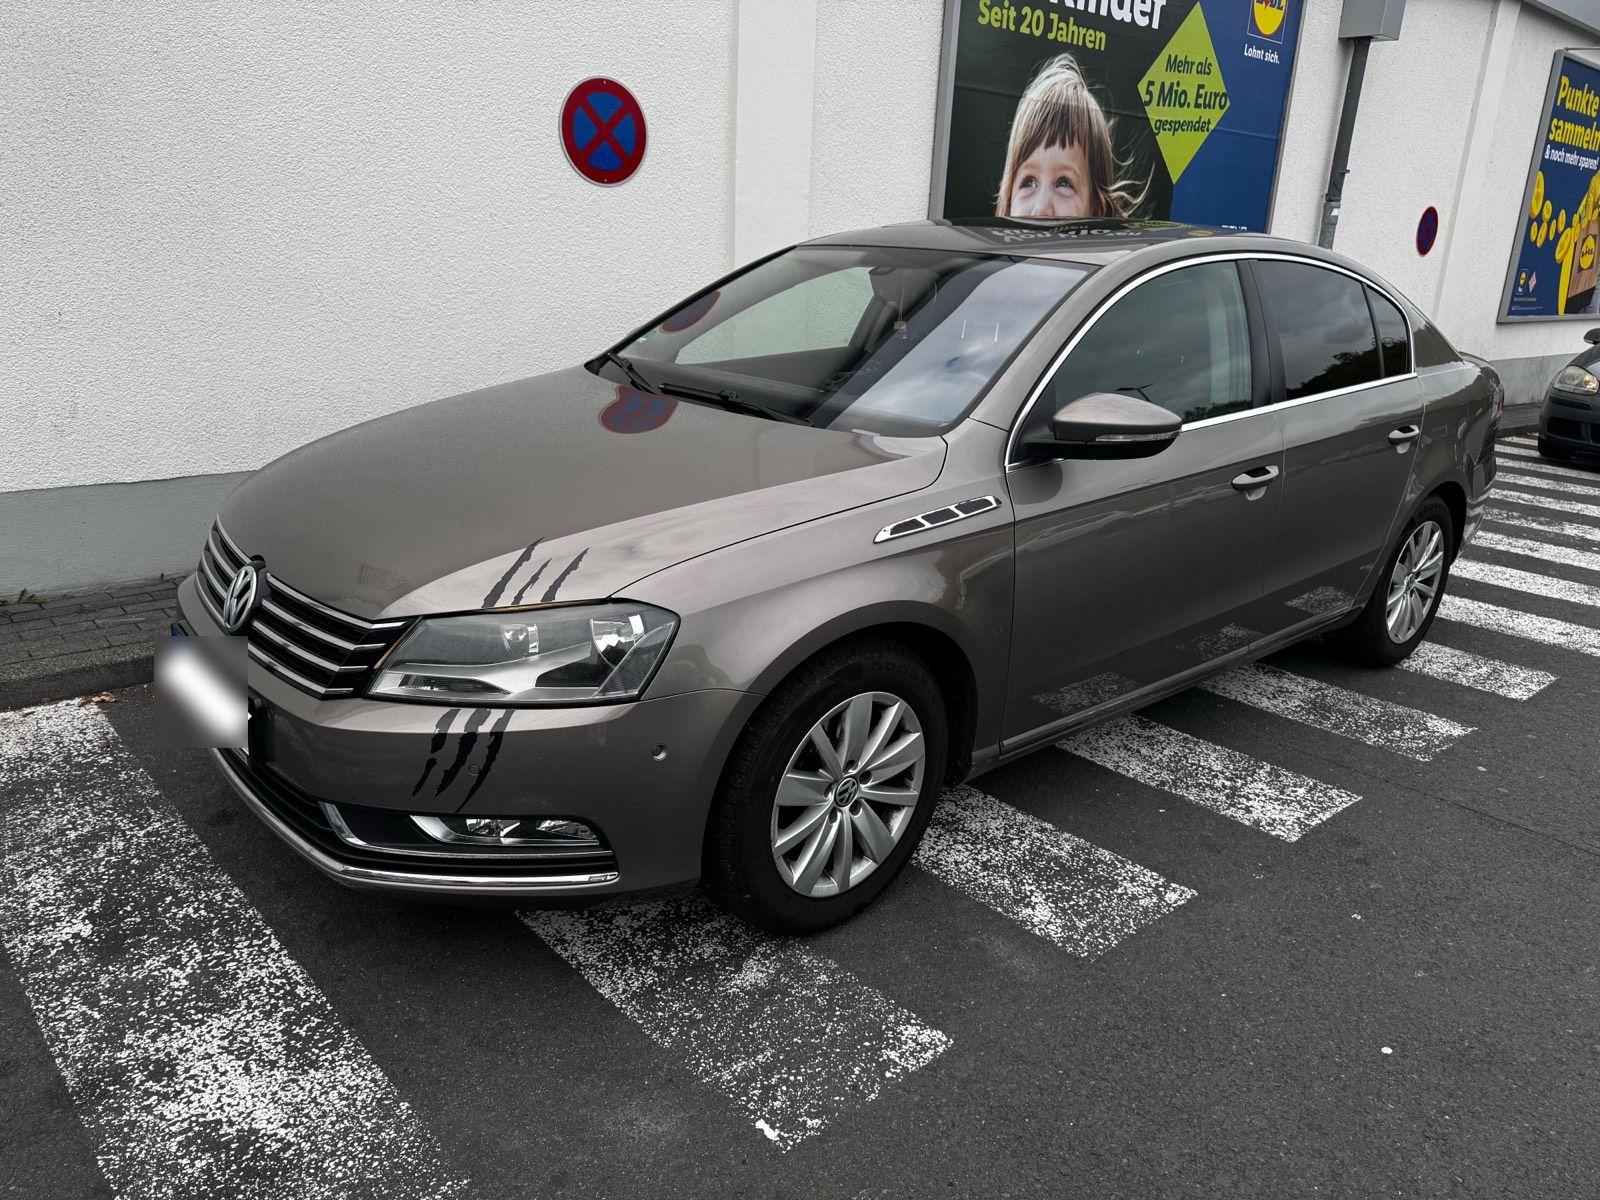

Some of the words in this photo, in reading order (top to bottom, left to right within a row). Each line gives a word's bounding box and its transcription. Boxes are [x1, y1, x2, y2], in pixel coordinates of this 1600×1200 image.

[978, 0, 1016, 31] Seit
[1019, 6, 1044, 37] 20
[1047, 13, 1106, 50] Jahren
[1050, 0, 1166, 29] nder
[1165, 54, 1195, 74] Mehr
[1196, 57, 1212, 76] als
[1244, 43, 1264, 60] Lohnt
[1264, 49, 1280, 65] sich.
[1144, 80, 1155, 107] 5
[1156, 80, 1190, 109] Mio.
[1194, 84, 1228, 110] Euro
[1557, 75, 1599, 118] Punkte
[1154, 115, 1211, 137] gespendet
[1545, 144, 1551, 159] &
[1550, 147, 1565, 163] noch
[1564, 150, 1579, 166] mehr
[1578, 156, 1599, 170] sparen!
